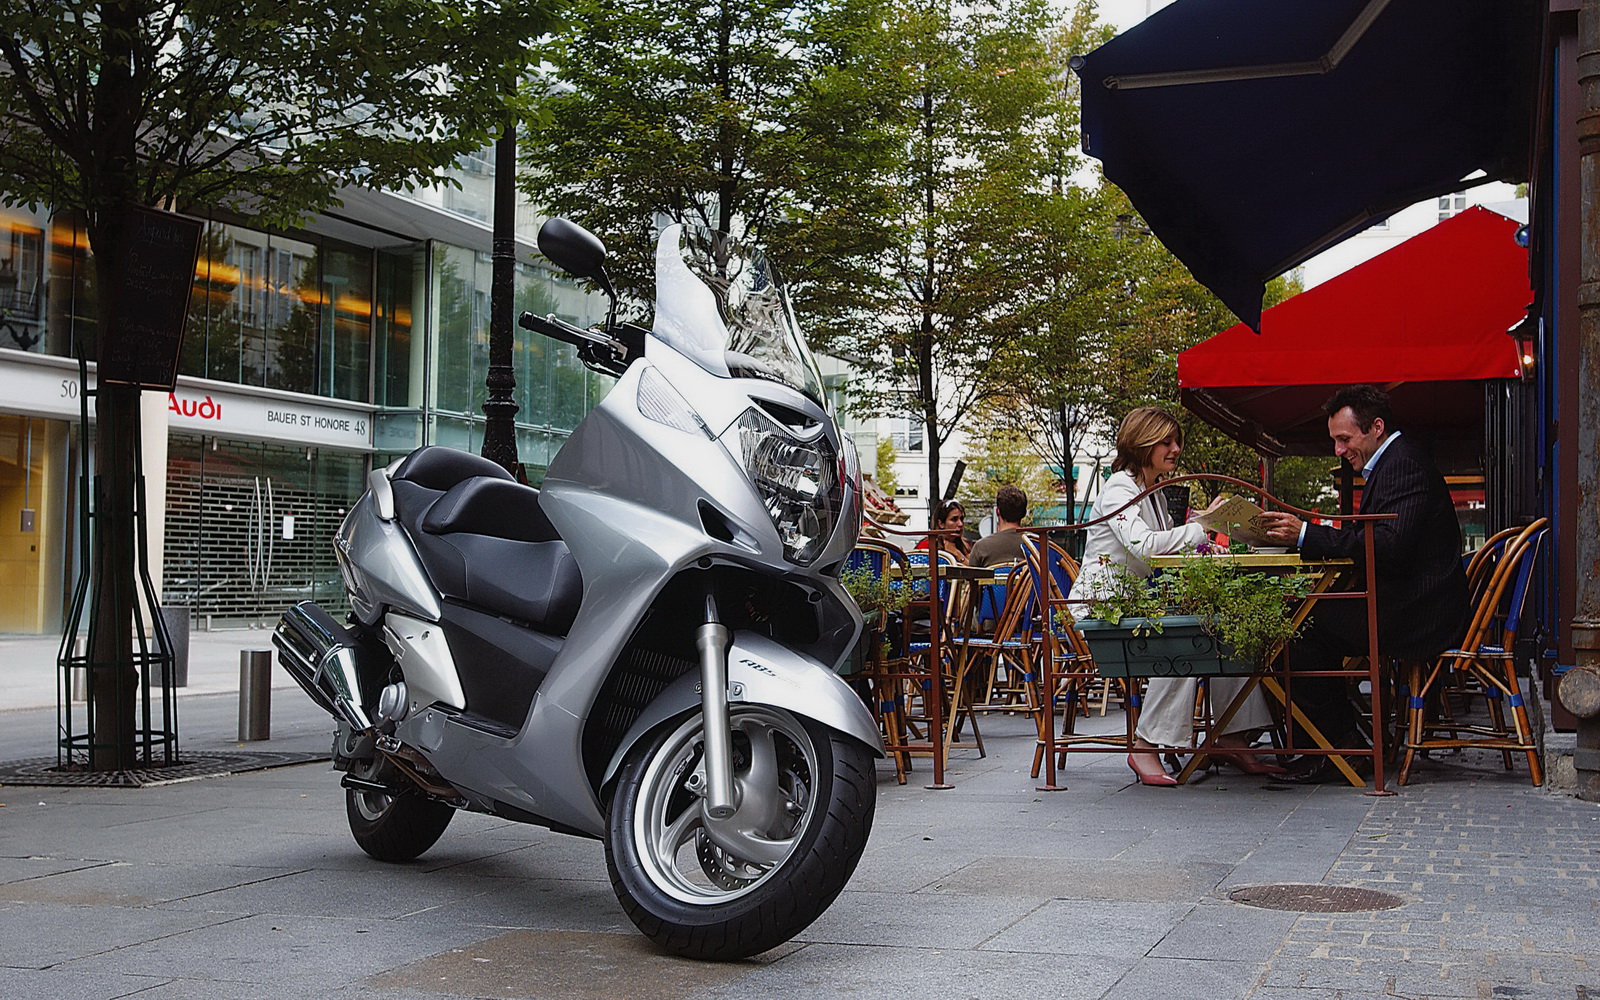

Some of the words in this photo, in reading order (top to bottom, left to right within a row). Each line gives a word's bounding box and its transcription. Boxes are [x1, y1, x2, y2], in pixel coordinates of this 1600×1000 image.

[60, 379, 77, 399] 50
[168, 392, 222, 421] Audi
[267, 410, 297, 425] BAUER
[300, 415, 312, 427] ST
[314, 417, 350, 432] HONORE
[354, 420, 366, 436] 48
[738, 659, 776, 677] ABS
